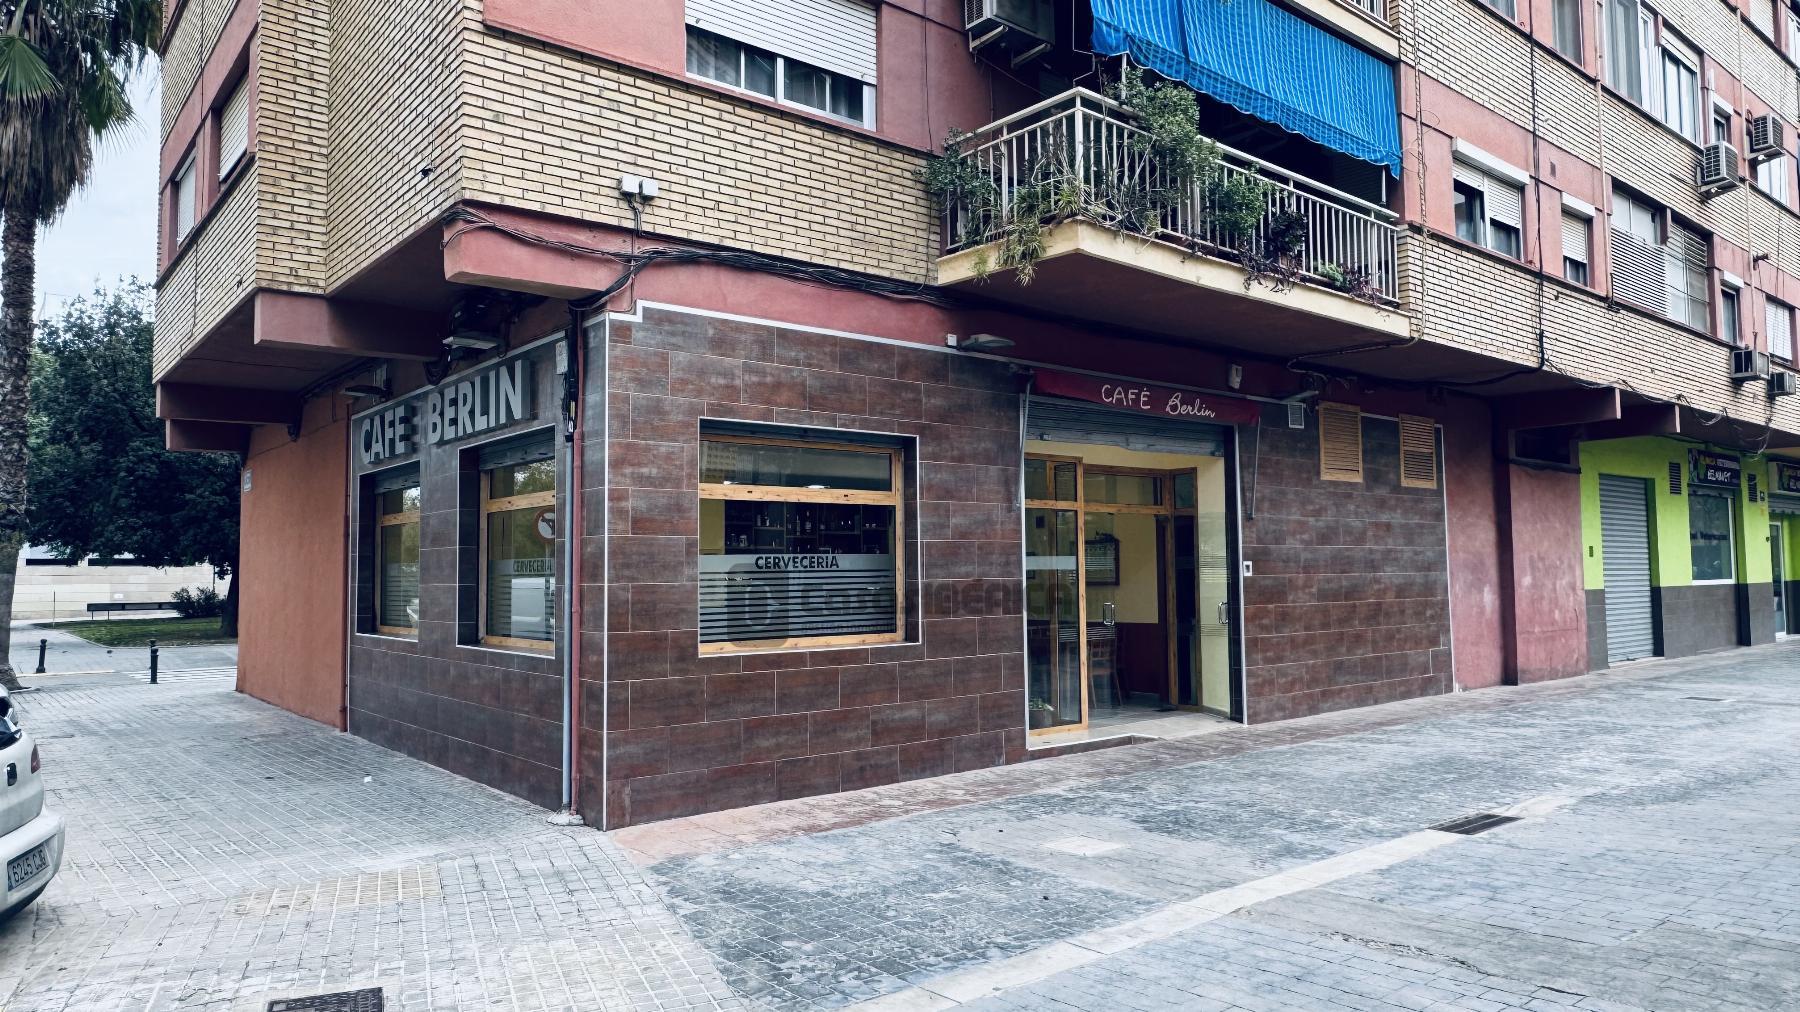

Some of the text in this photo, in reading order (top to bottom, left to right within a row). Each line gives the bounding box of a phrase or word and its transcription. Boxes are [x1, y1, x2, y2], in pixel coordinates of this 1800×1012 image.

[360, 359, 522, 464] CAFE BERLIN
[1165, 392, 1216, 418] Berlin
[12, 857, 33, 882] 6245
